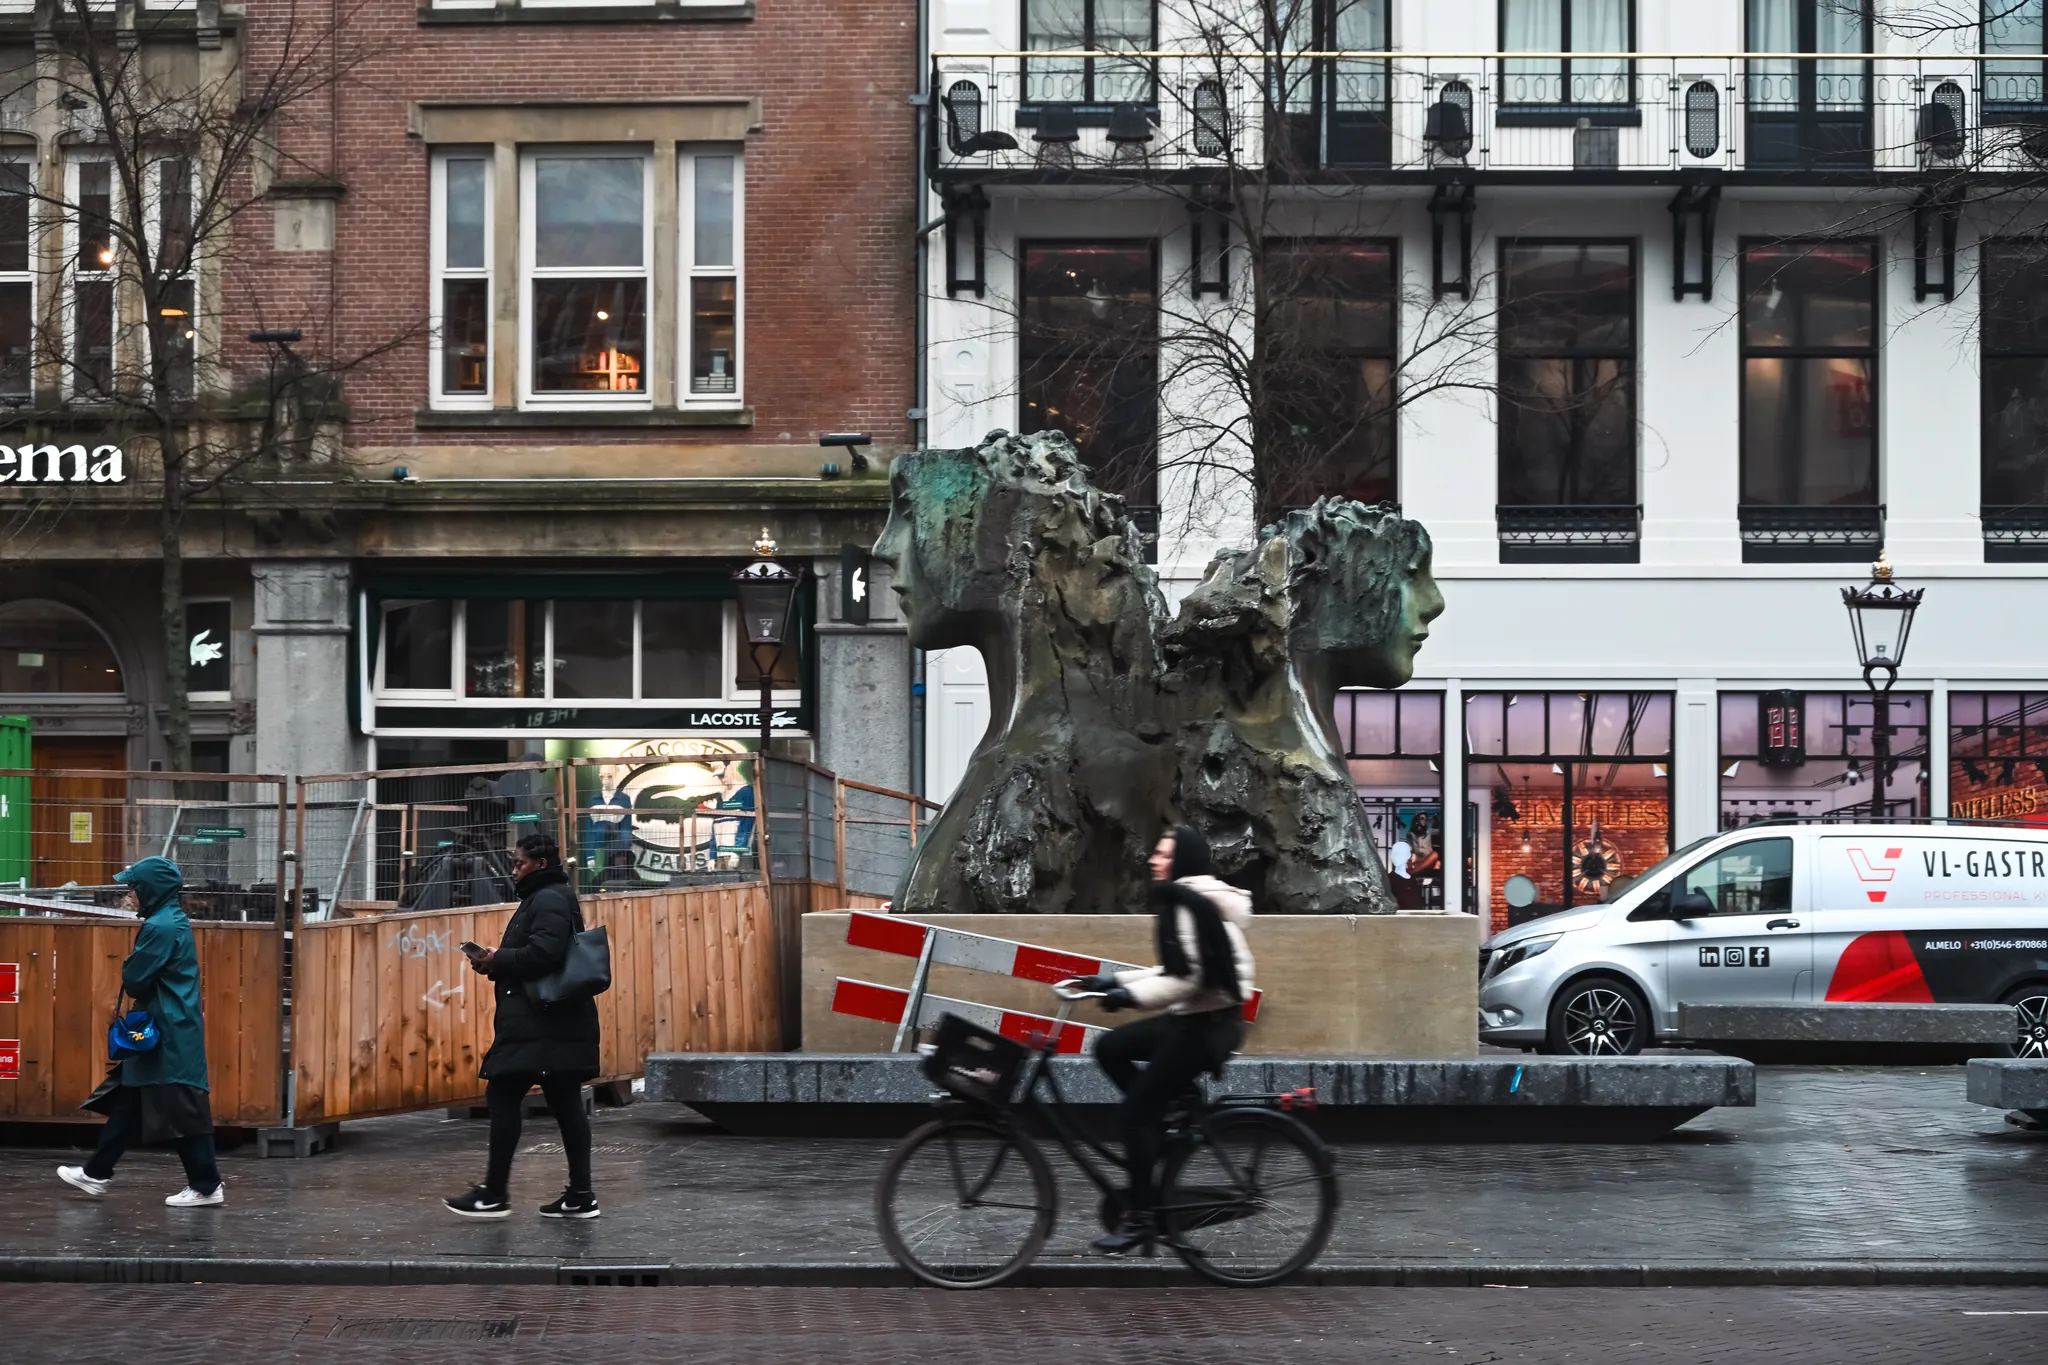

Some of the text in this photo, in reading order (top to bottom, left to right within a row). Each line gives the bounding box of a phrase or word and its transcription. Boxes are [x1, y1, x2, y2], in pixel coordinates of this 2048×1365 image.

[691, 713, 762, 726] LACOSTE
[1923, 850, 2046, 878] VL-GASTR
[1923, 891, 2027, 901] PROFESSIONAL
[1925, 941, 1961, 950] ALMELO
